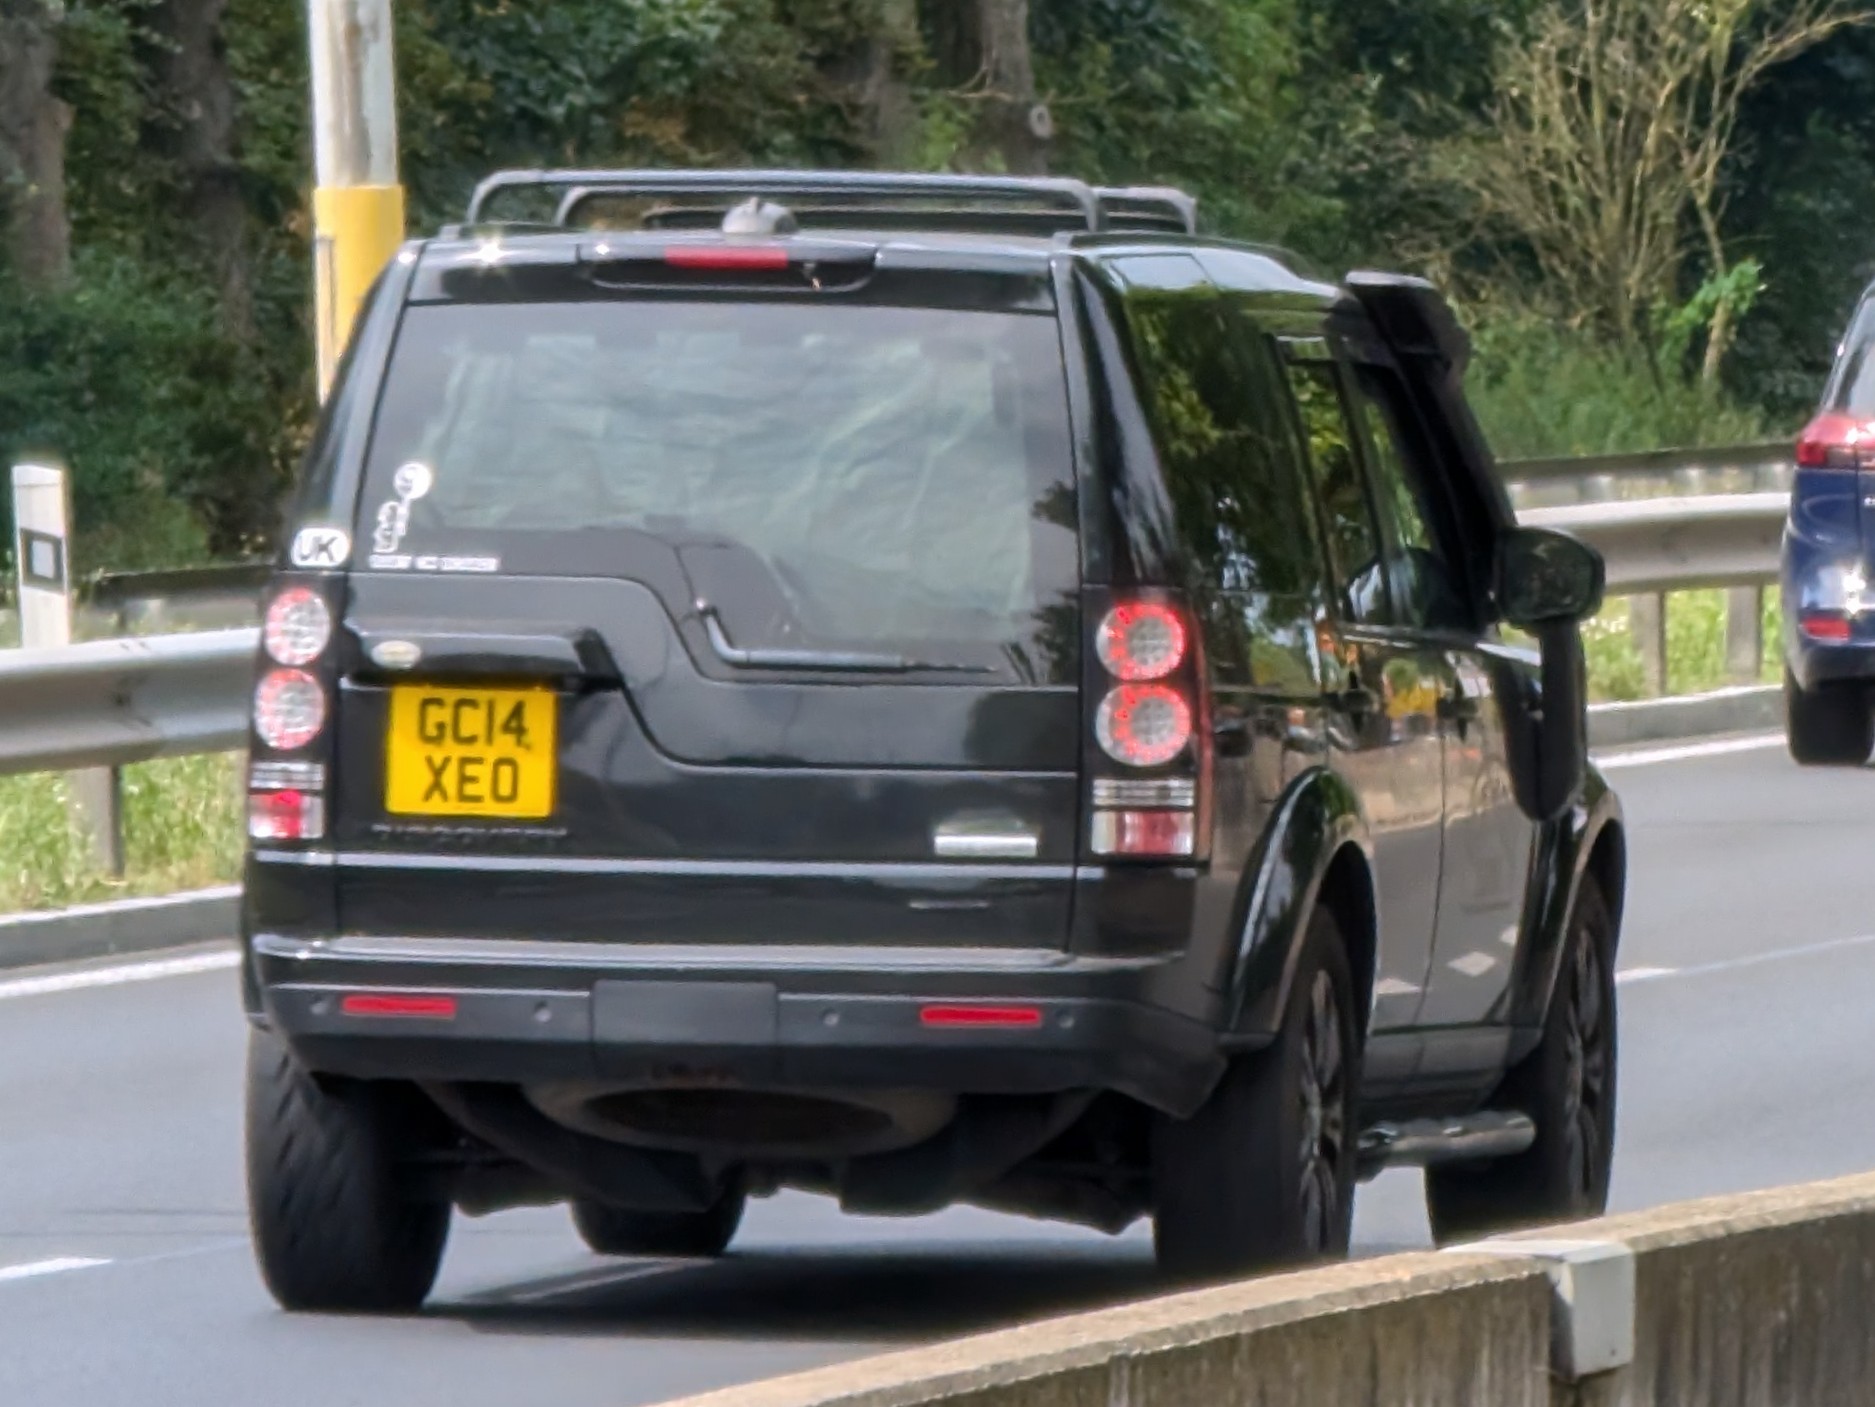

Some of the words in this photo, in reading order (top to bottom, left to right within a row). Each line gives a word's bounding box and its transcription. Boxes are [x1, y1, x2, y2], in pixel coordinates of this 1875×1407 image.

[297, 535, 338, 562] UK
[419, 697, 527, 746] GC14
[423, 755, 519, 804] XEO
